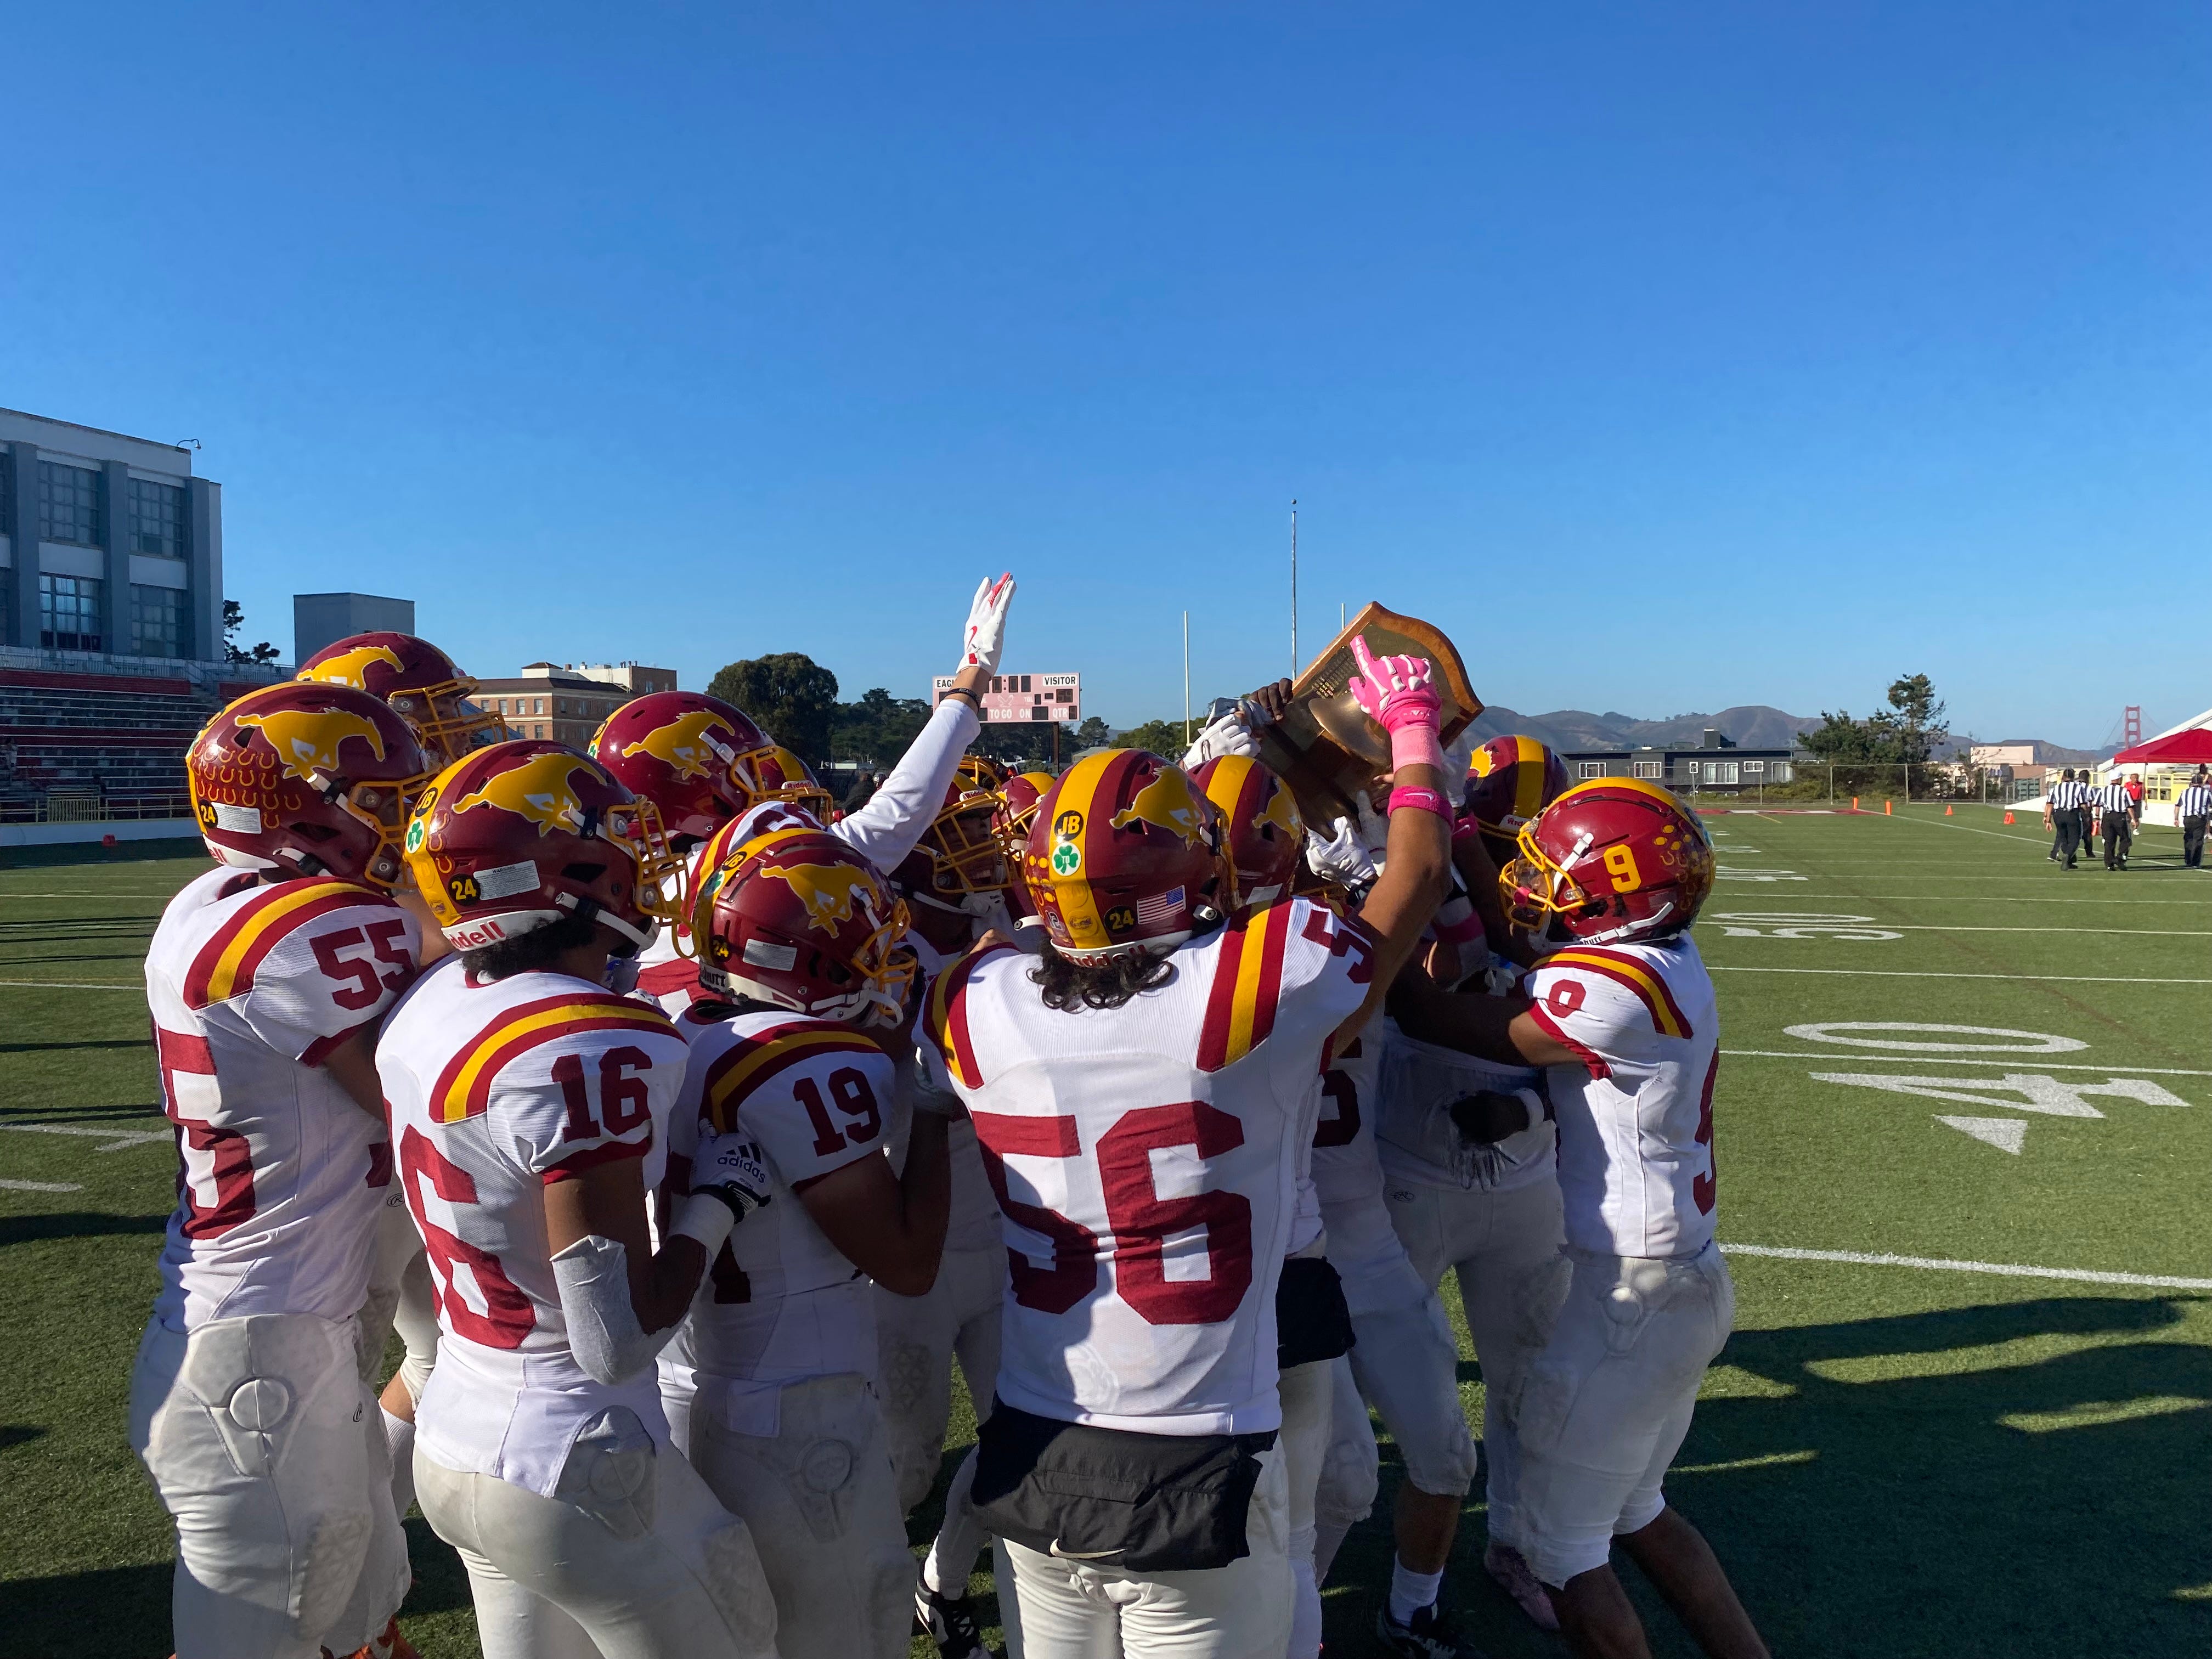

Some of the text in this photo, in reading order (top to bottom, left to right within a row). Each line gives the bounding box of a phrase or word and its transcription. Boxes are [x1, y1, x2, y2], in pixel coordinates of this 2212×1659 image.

[936, 679, 954, 687] EAG
[1044, 676, 1076, 685] VISITOR
[989, 709, 1012, 719] TO GO
[1019, 708, 1031, 718] ON
[1052, 708, 1068, 719] QTR
[416, 791, 436, 811] JB
[200, 804, 216, 823] 24
[1058, 815, 1080, 836] JB
[724, 854, 744, 867] JB
[1603, 844, 1641, 893] 9
[452, 879, 477, 900] 24
[1109, 910, 1135, 930] 24
[449, 920, 506, 950] ddell
[1301, 909, 1373, 984] 5
[309, 919, 413, 1011] 55
[551, 1045, 653, 1143] 16
[793, 1066, 882, 1157] 19
[716, 1155, 766, 1183] adidas
[969, 1100, 1253, 1325] 56
